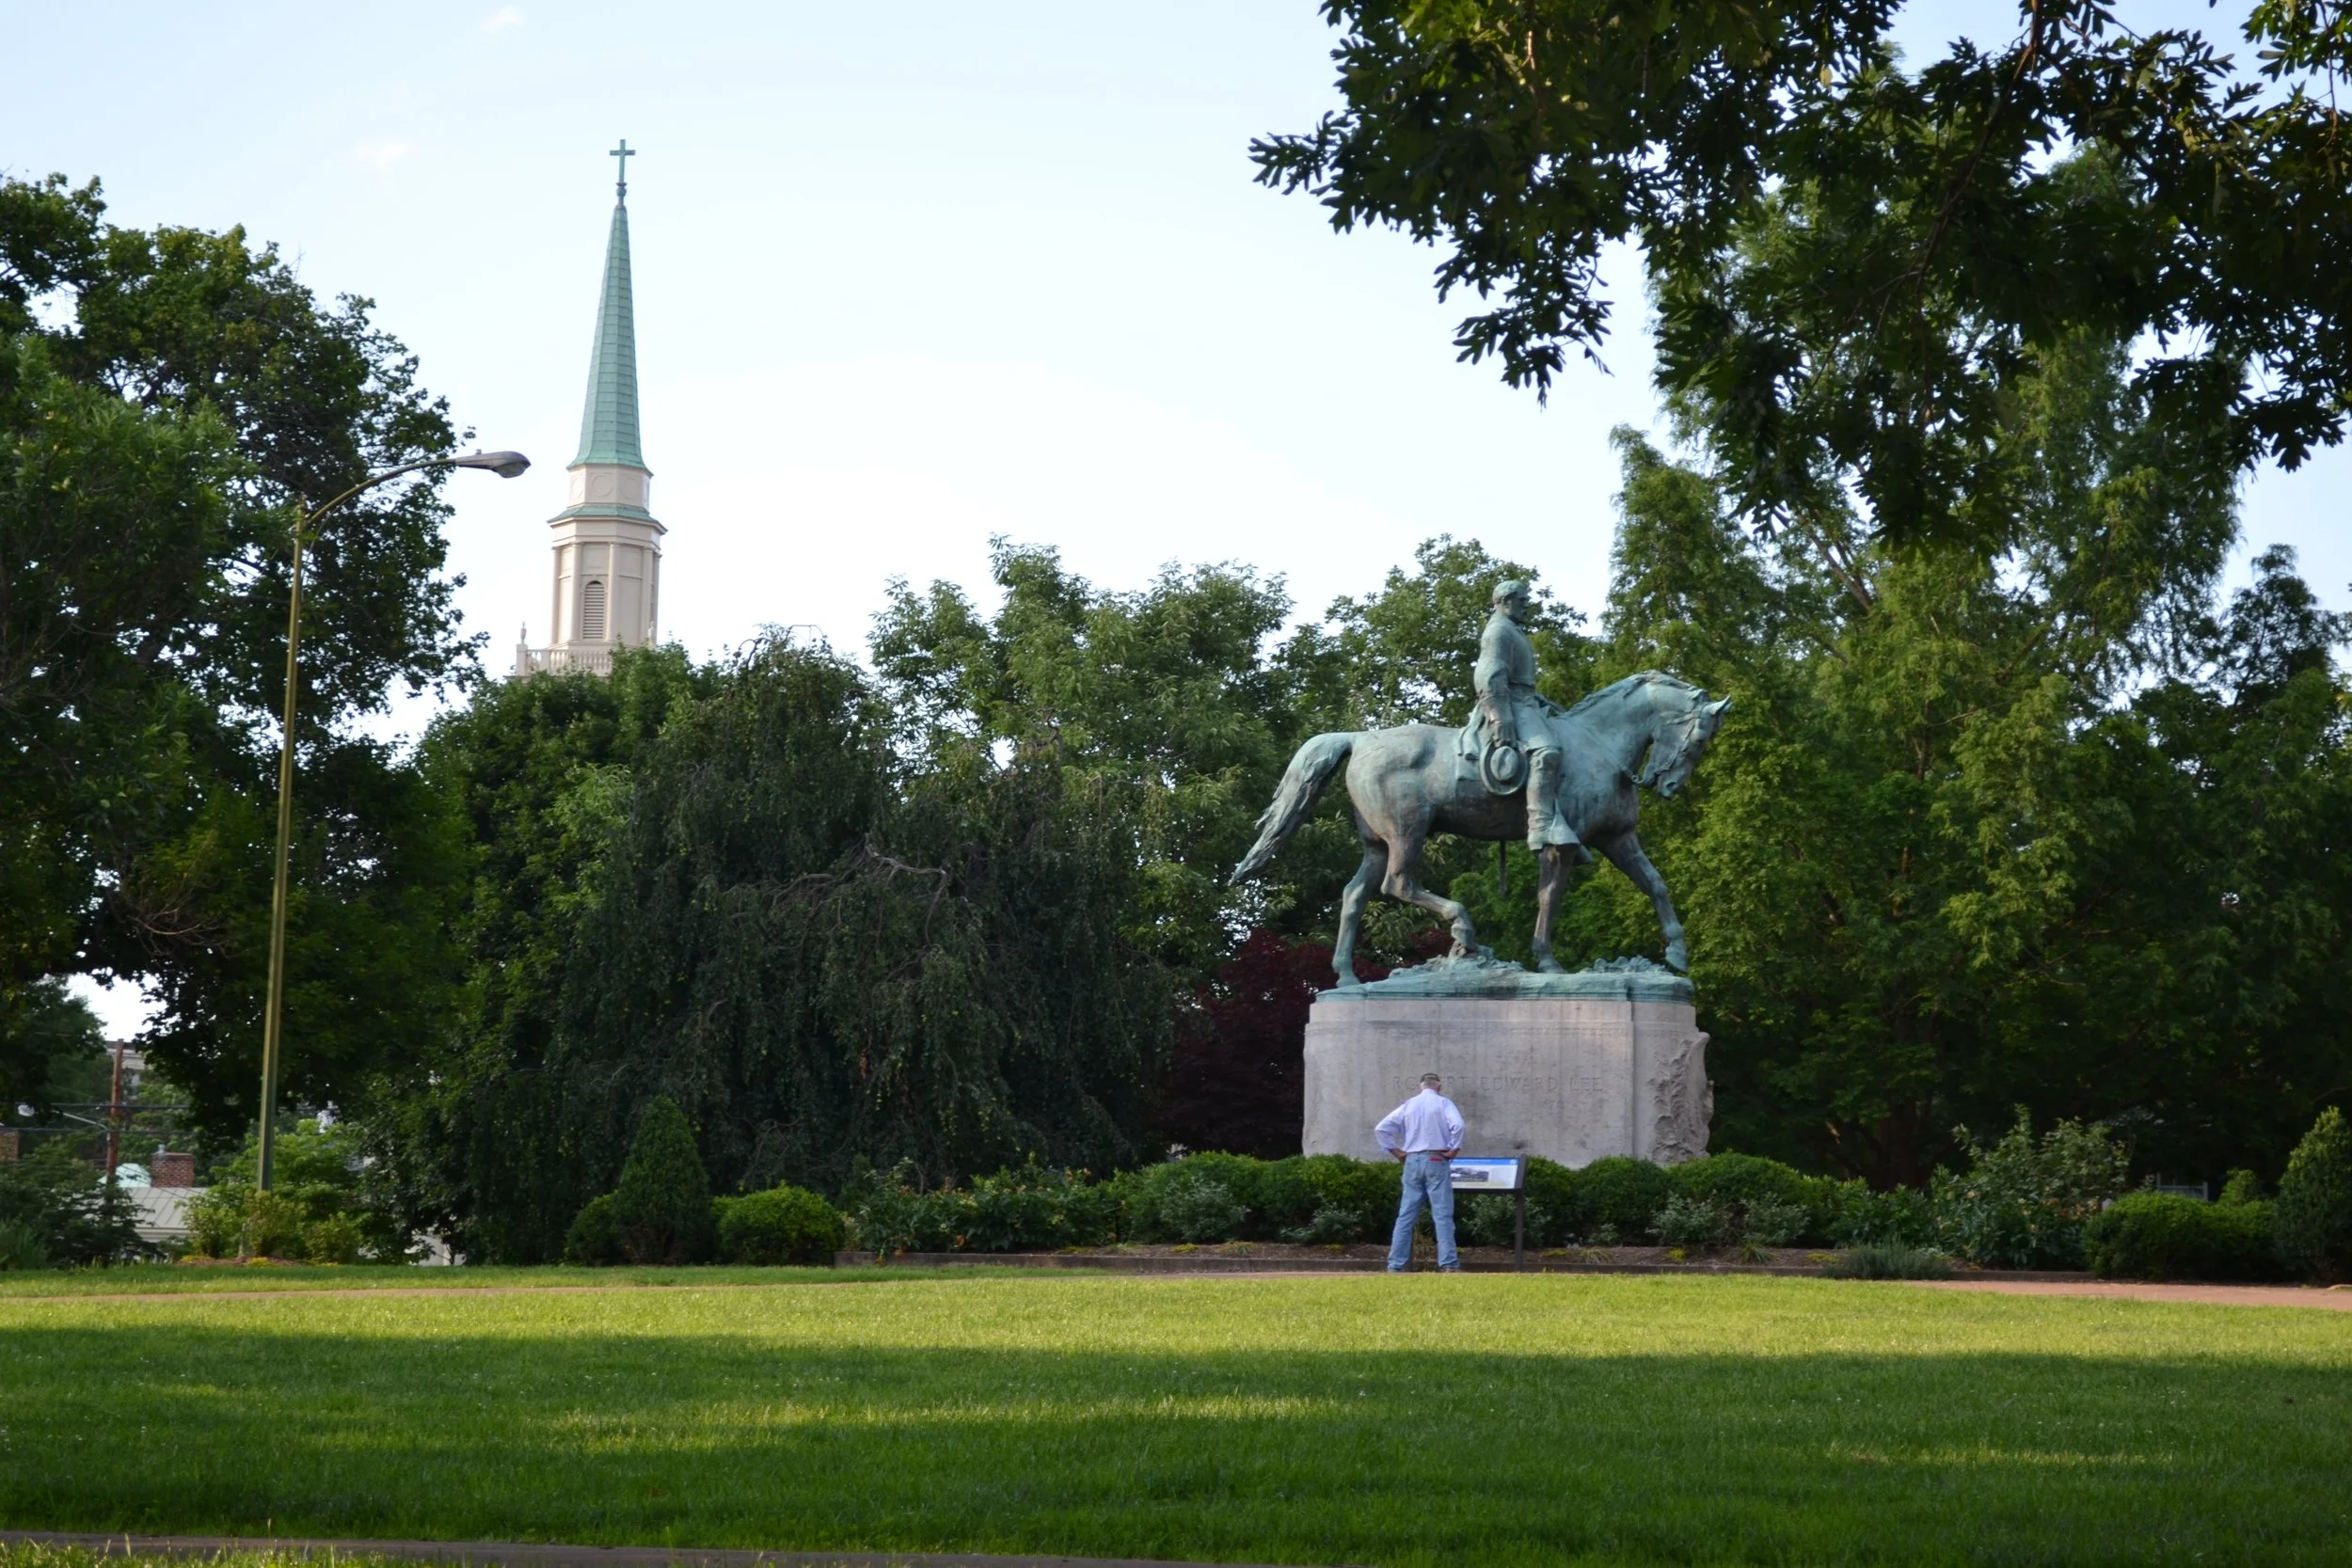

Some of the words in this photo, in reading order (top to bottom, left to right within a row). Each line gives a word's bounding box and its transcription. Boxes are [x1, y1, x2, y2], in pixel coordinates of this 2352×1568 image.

[1392, 1075, 1468, 1092] RORT
[1480, 1076, 1558, 1092] EDWARD
[1569, 1076, 1603, 1092] LEE
